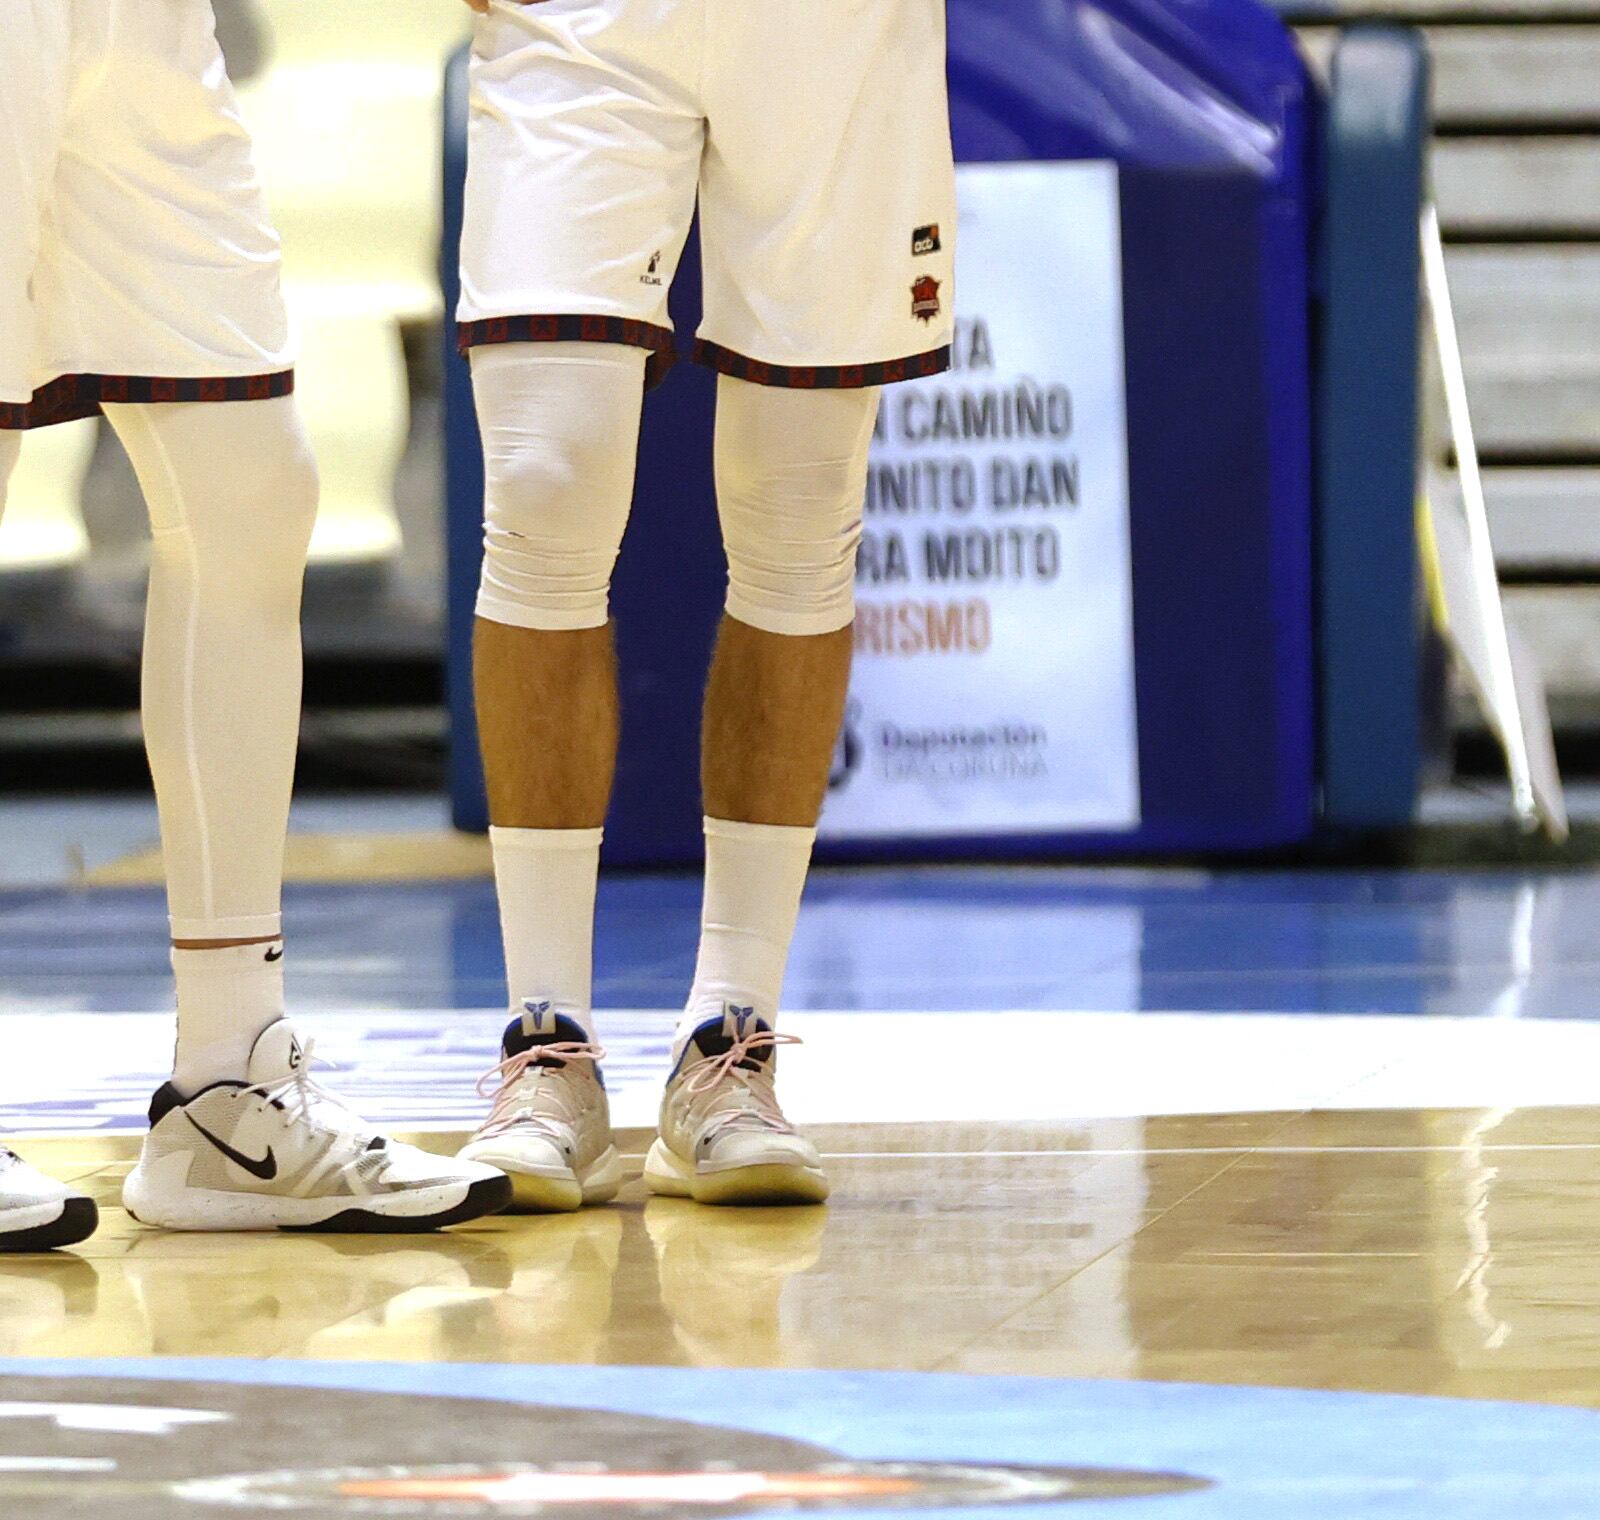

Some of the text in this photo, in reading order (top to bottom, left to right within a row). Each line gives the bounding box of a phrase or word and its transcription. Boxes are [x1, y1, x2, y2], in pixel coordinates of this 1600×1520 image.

[902, 376, 1075, 442] CAMIÑO
[991, 454, 1082, 514] DAN
[923, 524, 1062, 586] MOITO
